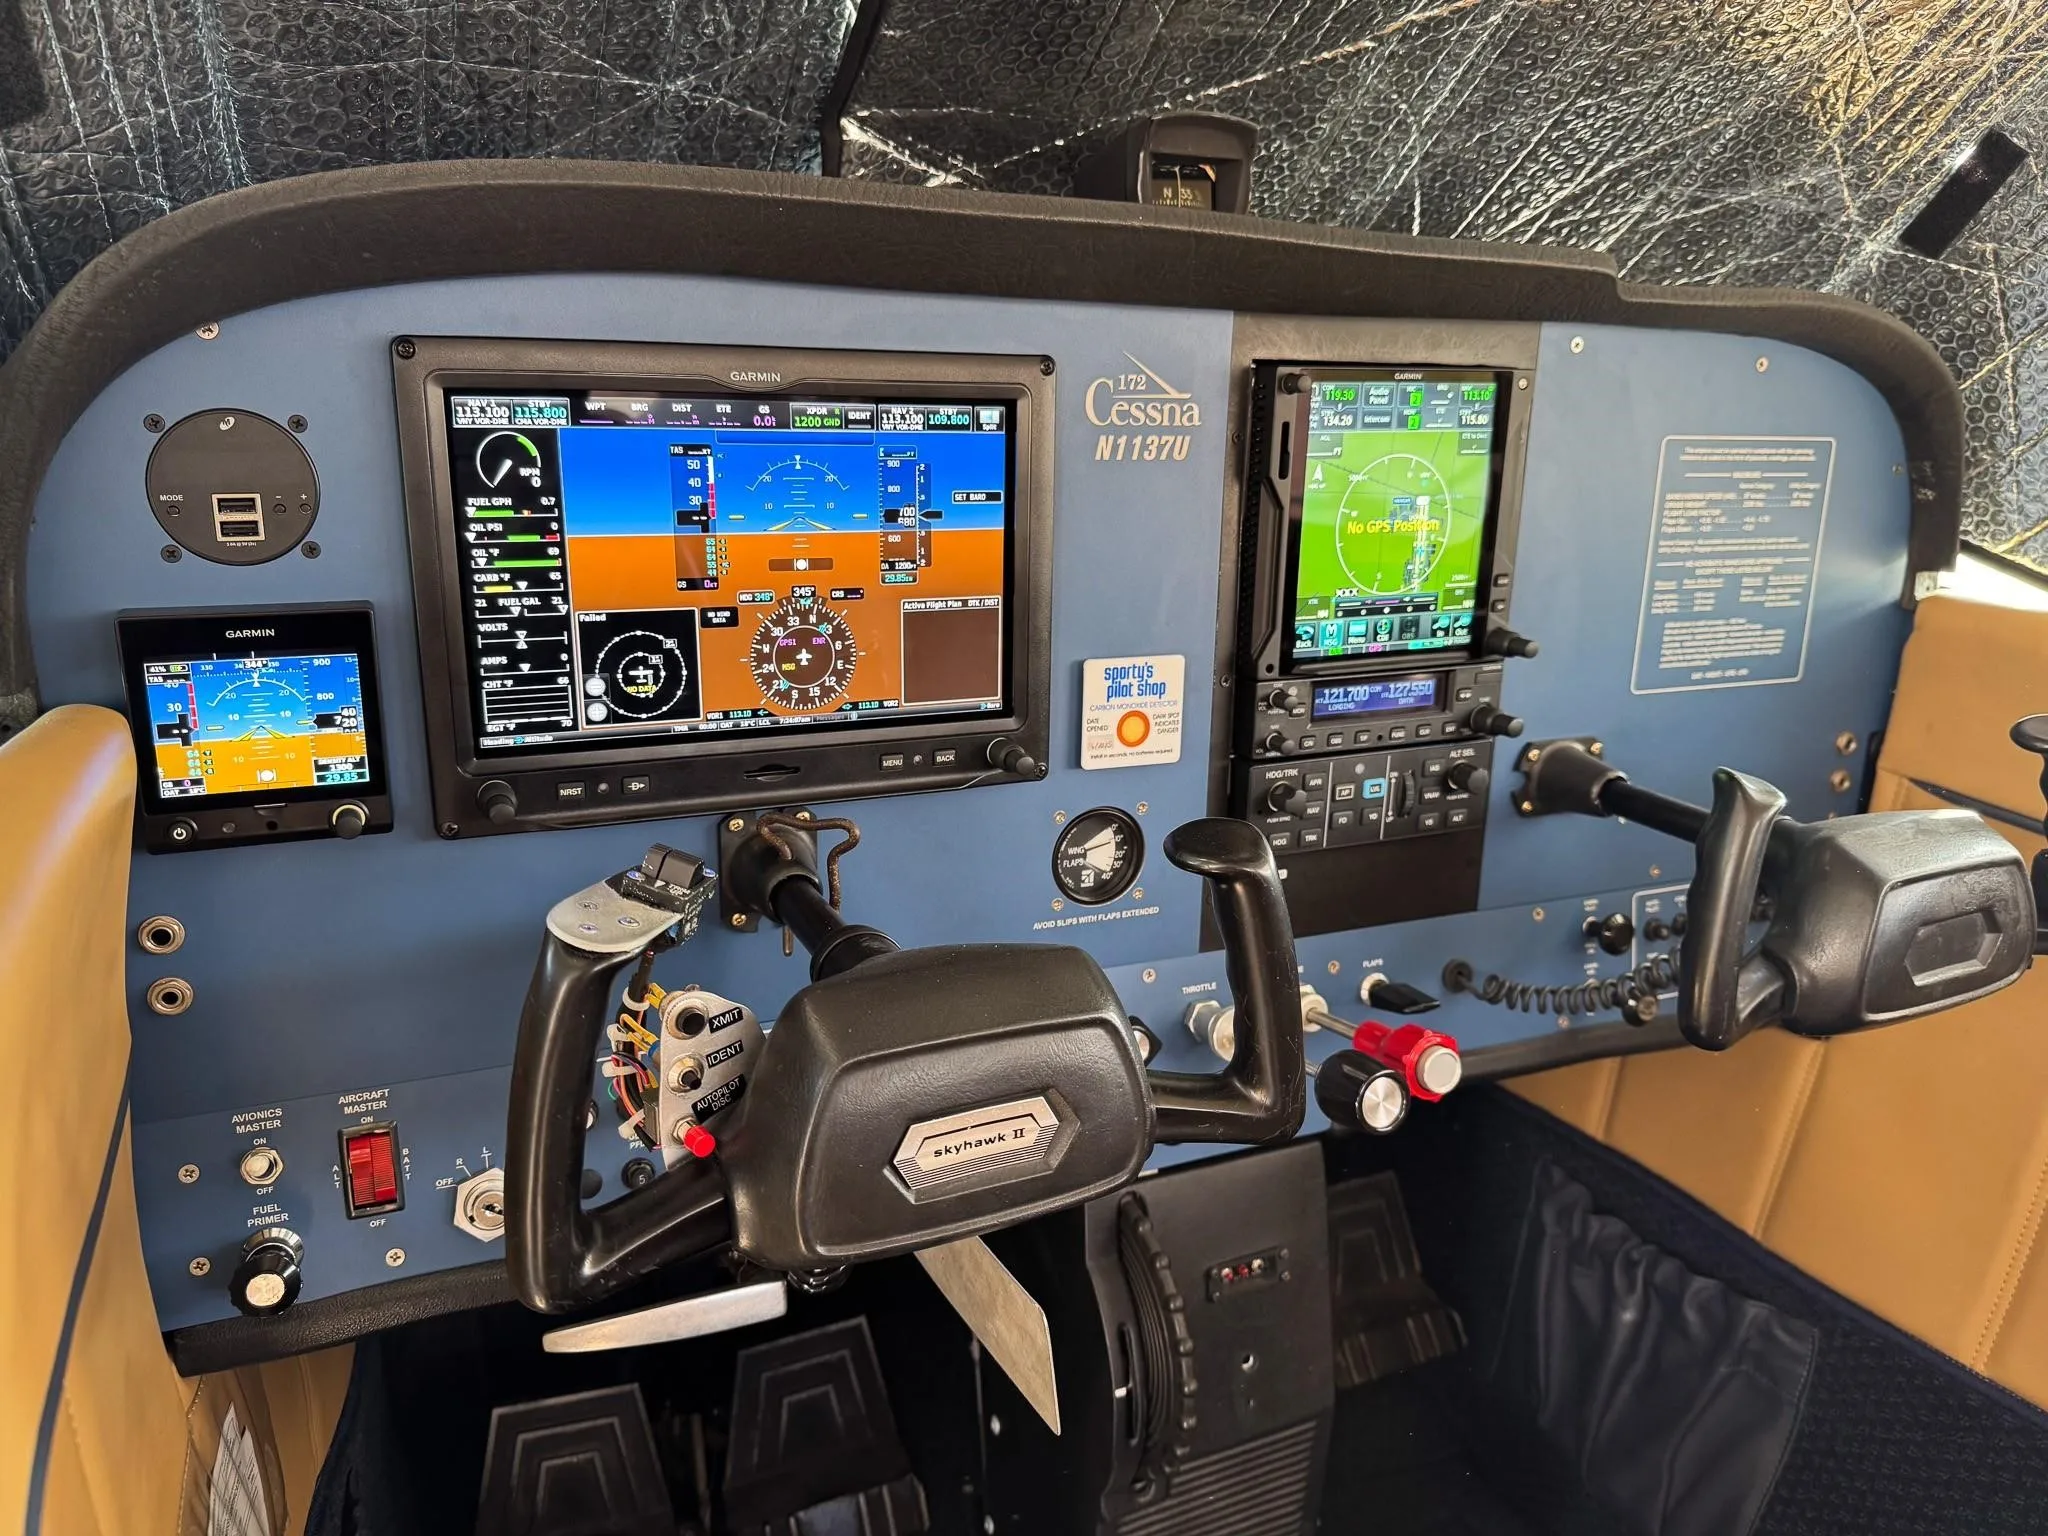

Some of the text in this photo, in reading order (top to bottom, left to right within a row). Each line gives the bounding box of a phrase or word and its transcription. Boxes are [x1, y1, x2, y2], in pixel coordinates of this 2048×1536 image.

[1163, 188, 1172, 198] N
[730, 371, 781, 383] GARMIN
[1118, 374, 1146, 390] 172
[1369, 387, 1389, 395] Audio
[527, 400, 551, 408] STBY
[1085, 377, 1201, 427] Cessna
[1369, 396, 1388, 405] Panel
[585, 402, 606, 411] WPT
[632, 402, 648, 411] BRG
[672, 403, 692, 412] DIST
[716, 404, 731, 413] ETE
[759, 406, 770, 414] GS
[456, 407, 509, 417] 113.100
[515, 407, 566, 418] 115.800
[848, 411, 871, 421] IDENT
[794, 417, 841, 427] 1200 GND
[882, 414, 924, 424] 113.100
[929, 415, 969, 424] 109.800
[1323, 415, 1353, 426] 134.20
[1094, 434, 1191, 461] N1137U
[687, 460, 700, 470] 50
[887, 460, 900, 468] 900
[520, 468, 541, 476] RPM
[532, 478, 541, 488] 0
[688, 478, 701, 487] 40
[762, 475, 771, 483] 20
[541, 497, 555, 505] 0.7
[689, 496, 702, 505] 30
[764, 502, 773, 510] 10
[469, 523, 503, 532] OIL PSI
[1347, 519, 1440, 534] No GPS Position
[888, 535, 901, 543] 600
[793, 587, 814, 596] 345°
[475, 599, 487, 607] 21
[499, 598, 541, 606] FUEL GAL
[552, 597, 563, 605] 21
[904, 600, 963, 609] Active Flight Plan
[579, 614, 606, 622] Failed
[787, 617, 799, 625] 33
[809, 615, 816, 623] N
[478, 623, 508, 631] VOLTS
[771, 627, 783, 636] 30
[826, 625, 832, 634] 3
[225, 628, 275, 638] GARMIN
[763, 644, 769, 653] W
[835, 641, 842, 650] 6
[1296, 640, 1312, 648] Back
[313, 658, 331, 667] 900
[481, 657, 507, 665] AMPS
[837, 660, 843, 669] E
[762, 664, 774, 673] 24
[1104, 662, 1153, 683] sporty's
[825, 677, 836, 686] 12
[279, 689, 290, 697] 20
[809, 687, 820, 696] 15
[1107, 680, 1166, 702] pilot shop
[1389, 680, 1432, 698] 127.550
[226, 692, 236, 700] 20
[317, 692, 334, 701] 800
[792, 690, 798, 699] S
[1323, 686, 1369, 703] 121.700
[167, 703, 182, 712] 30
[341, 708, 356, 716] 40
[1090, 704, 1115, 712] CARBON
[1450, 748, 1476, 758] ALT SEL
[882, 758, 903, 767] MENU
[936, 753, 955, 763] BACK
[326, 772, 358, 782] 29.85
[1266, 769, 1298, 779] HDG/TRK
[560, 788, 582, 796] NRST
[1068, 846, 1085, 854] WING
[1063, 858, 1084, 868] FLAPS
[1033, 906, 1159, 930] AVOID SLIPS WITH FLAPS EXTENDED
[1363, 959, 1383, 967] FLAPS
[1182, 982, 1217, 994] THROTTLE
[712, 1008, 740, 1028] XMIT
[708, 1042, 741, 1066] IDENT
[338, 1088, 390, 1104] AIRCRAFT
[696, 1078, 740, 1111] AUTOPILOT
[344, 1100, 388, 1114] MASTER
[712, 1094, 731, 1112] DISC
[232, 1108, 282, 1124] AVIONICS
[360, 1116, 374, 1124] ON
[236, 1120, 282, 1134] MASTER
[253, 1137, 267, 1146] ON
[933, 1128, 1025, 1158] skyhawk II
[456, 1158, 463, 1166] R
[436, 1178, 454, 1187] OFF
[639, 1175, 645, 1184] 5
[256, 1186, 274, 1196] OFF
[252, 1204, 282, 1216] FUEL
[247, 1212, 289, 1228] PRIMER
[369, 1218, 386, 1228] OFF
